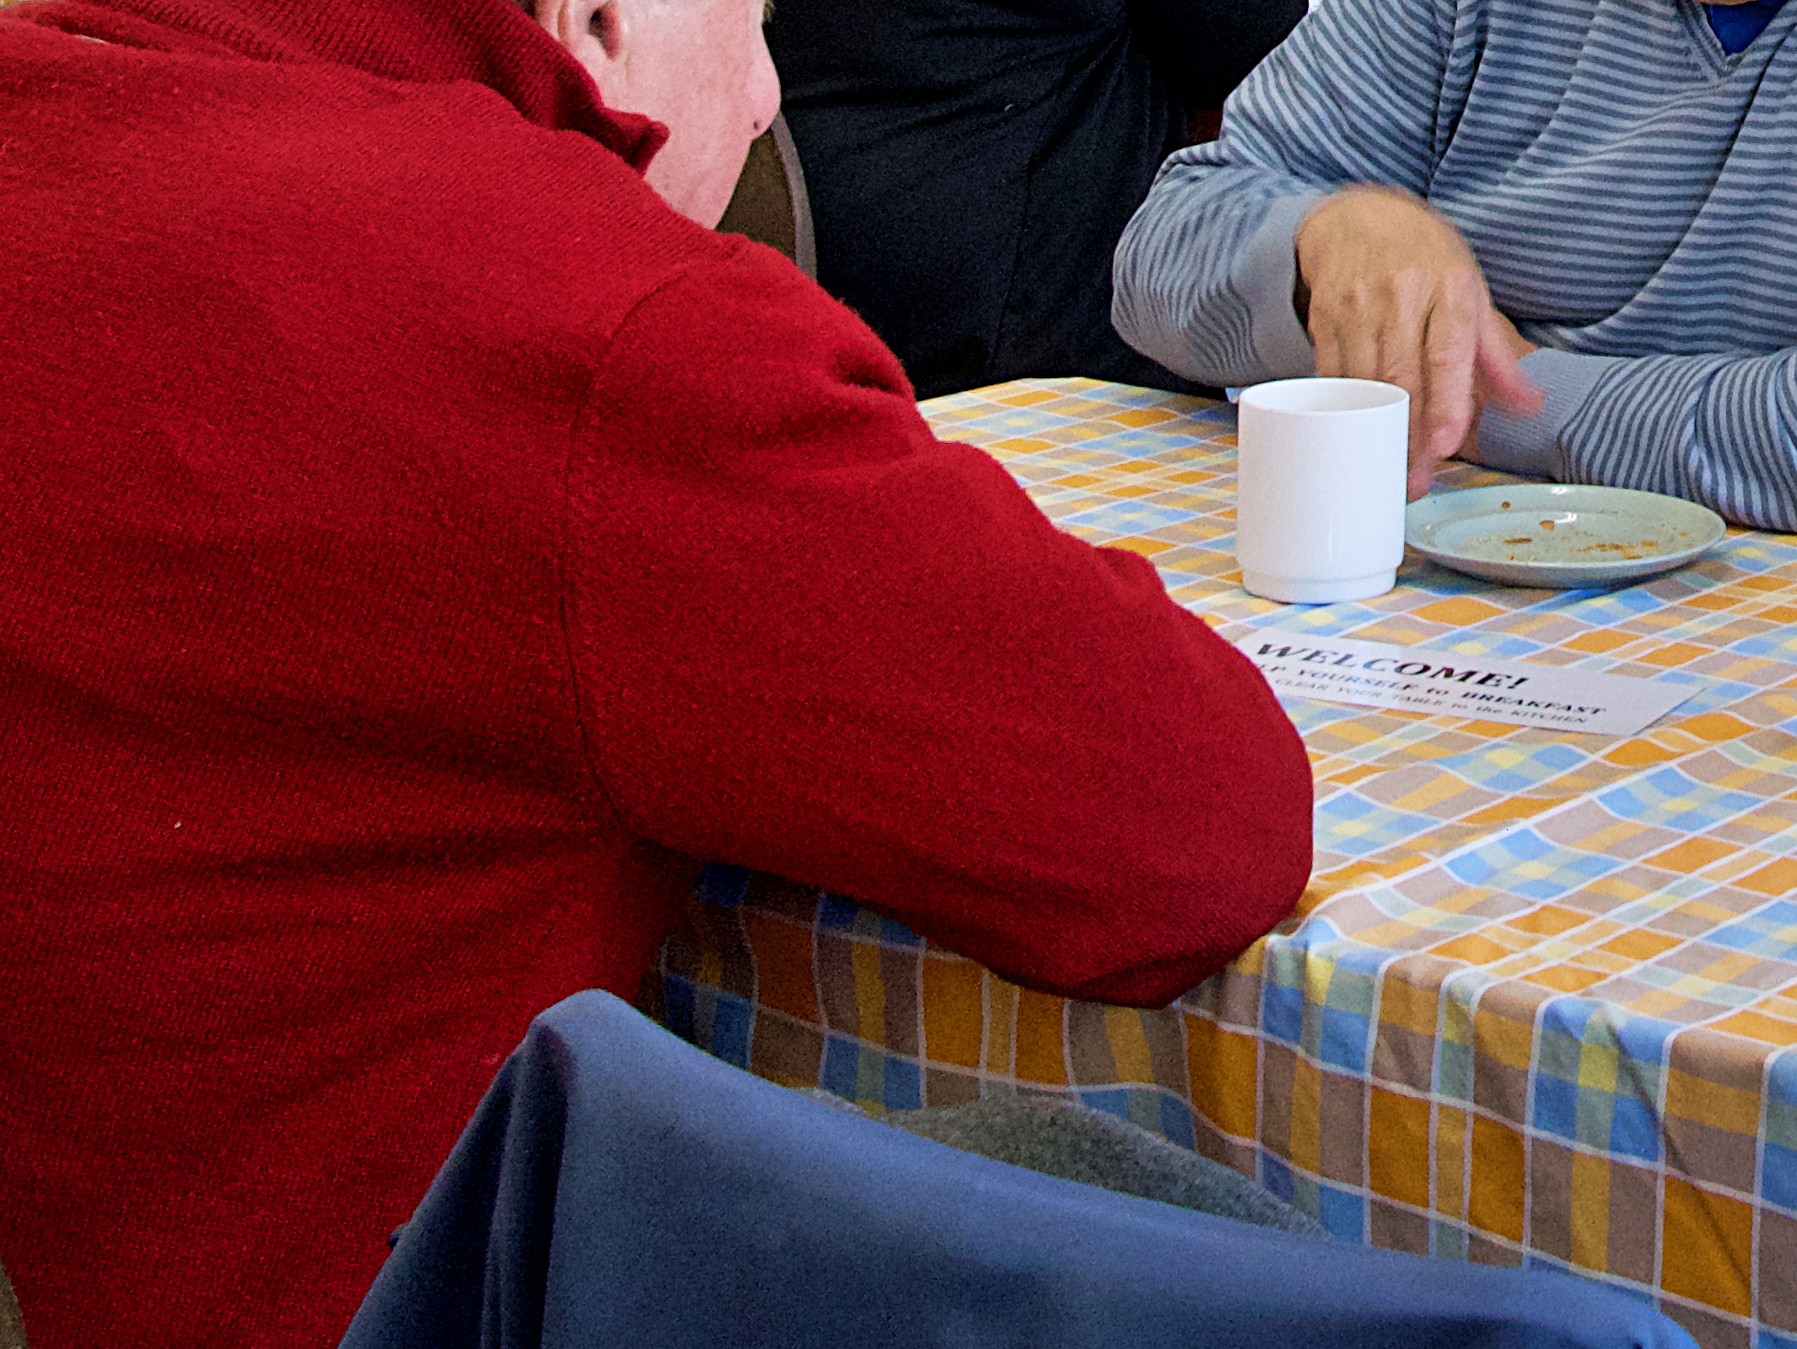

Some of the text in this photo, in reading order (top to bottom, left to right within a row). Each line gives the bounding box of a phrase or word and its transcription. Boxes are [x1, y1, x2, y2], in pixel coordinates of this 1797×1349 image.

[1256, 643, 1530, 689] WELCOME!
[1299, 669, 1419, 691] YOURSELF
[1460, 691, 1608, 715] BREAKFAST
[1511, 710, 1589, 724] KITCHEN
